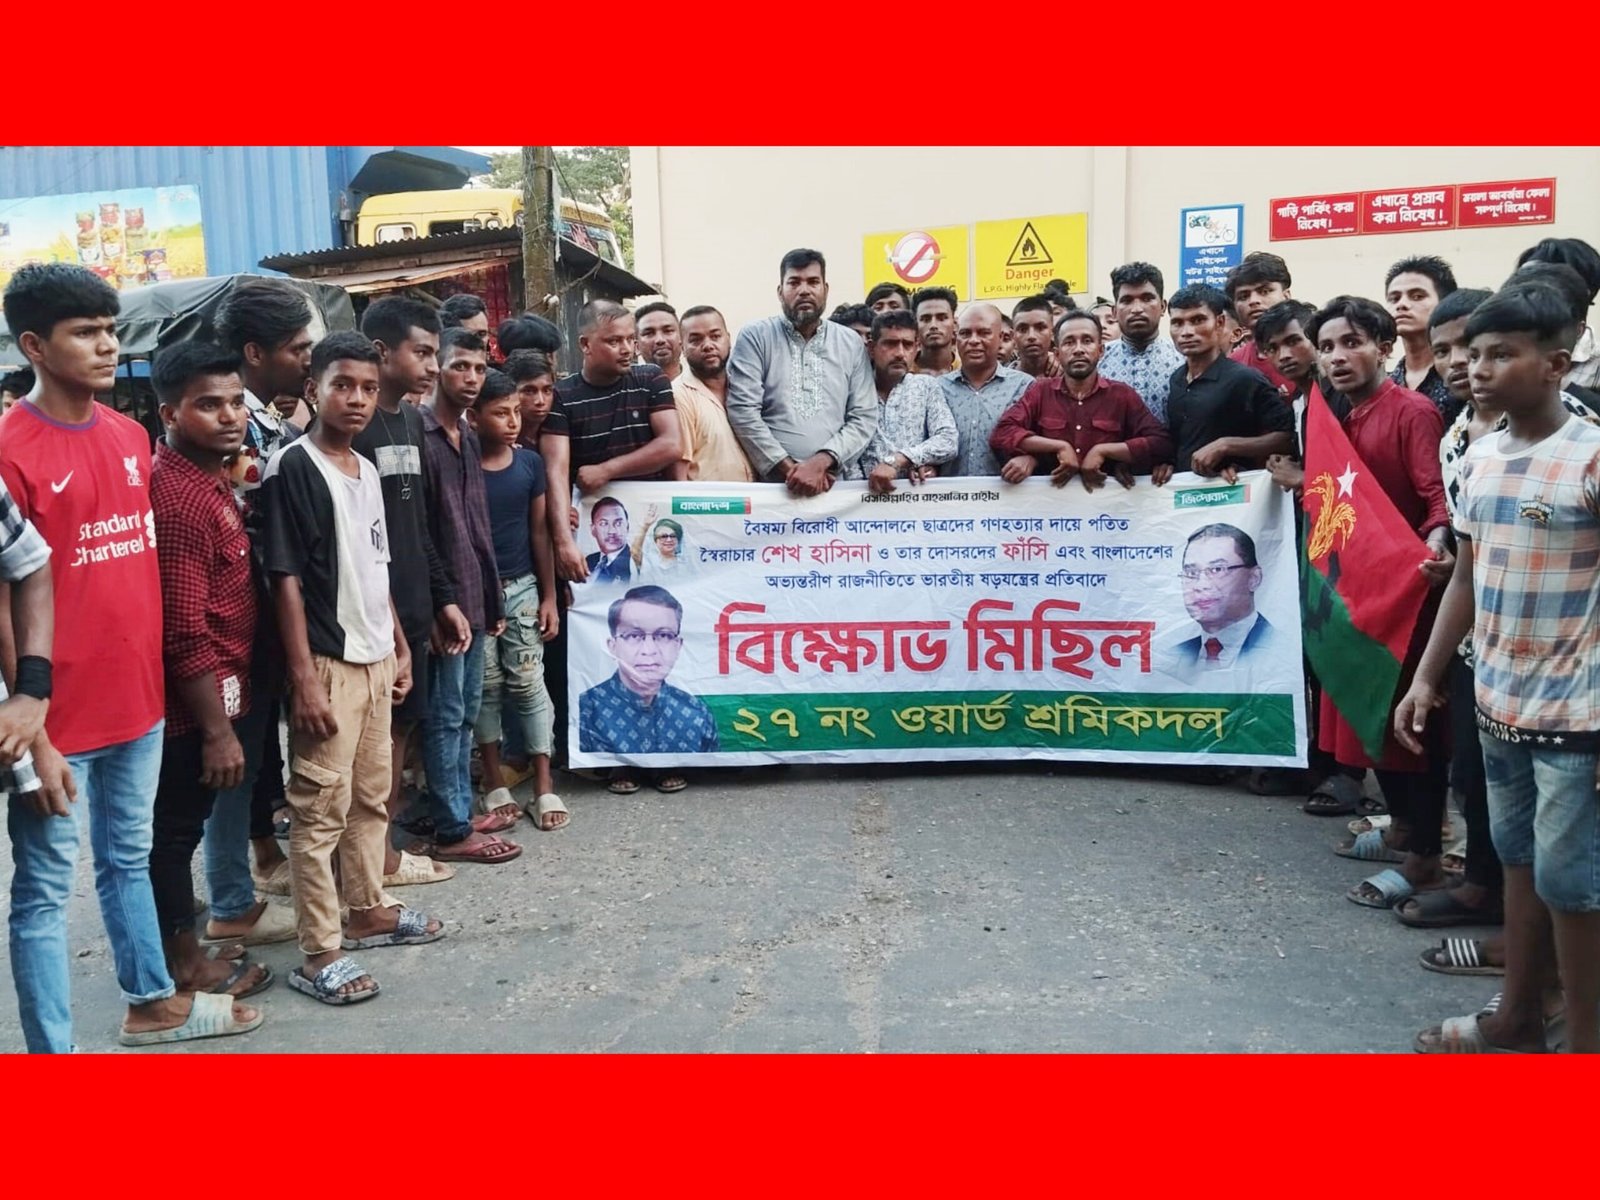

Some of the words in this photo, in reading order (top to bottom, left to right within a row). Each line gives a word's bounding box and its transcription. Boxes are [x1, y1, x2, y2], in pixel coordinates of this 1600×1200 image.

[1333, 201, 1355, 213] করা
[1371, 194, 1409, 207] এখানে
[1371, 211, 1397, 224] করা
[1005, 268, 1055, 281] Danger
[1006, 283, 1032, 292] Highly
[680, 501, 730, 511] বাংলাদেশ
[78, 510, 142, 541] Standard
[743, 518, 787, 536] বৈষম্য
[792, 517, 839, 535] বিরোধী
[846, 519, 916, 535] আন্দোলনে
[922, 518, 974, 533] ছাত্রদের
[980, 517, 1043, 533] গণহত্যার
[1049, 517, 1081, 532] দায়ে
[1088, 515, 1130, 532] পতিত
[70, 534, 145, 566] Chartered
[700, 546, 755, 563] স্বৈরাচার
[761, 545, 801, 563] শেখ
[810, 539, 872, 564] হাসিনা
[878, 548, 888, 560] ও
[894, 547, 922, 560] তার
[927, 546, 996, 561] দোসরদের
[1001, 537, 1049, 562] ফাঁসি
[1055, 546, 1085, 560] এবং
[1092, 545, 1173, 560] বাংলাদেশের
[765, 571, 831, 590] অভ্যন্তরীণ
[838, 571, 914, 589] রাজনীতিতে
[921, 570, 974, 588] ভারতীয়
[980, 572, 1039, 588] ষড়যন্ত্রের
[1045, 572, 1107, 588] প্রতিবাদে
[714, 602, 951, 675] বিক্ষোভ
[963, 599, 1156, 680] মিছিল
[733, 707, 800, 742] ২৭
[815, 705, 876, 739] নং
[891, 692, 1015, 736] ওয়ার্ড
[1023, 694, 1231, 742] শ্রমিকদল
